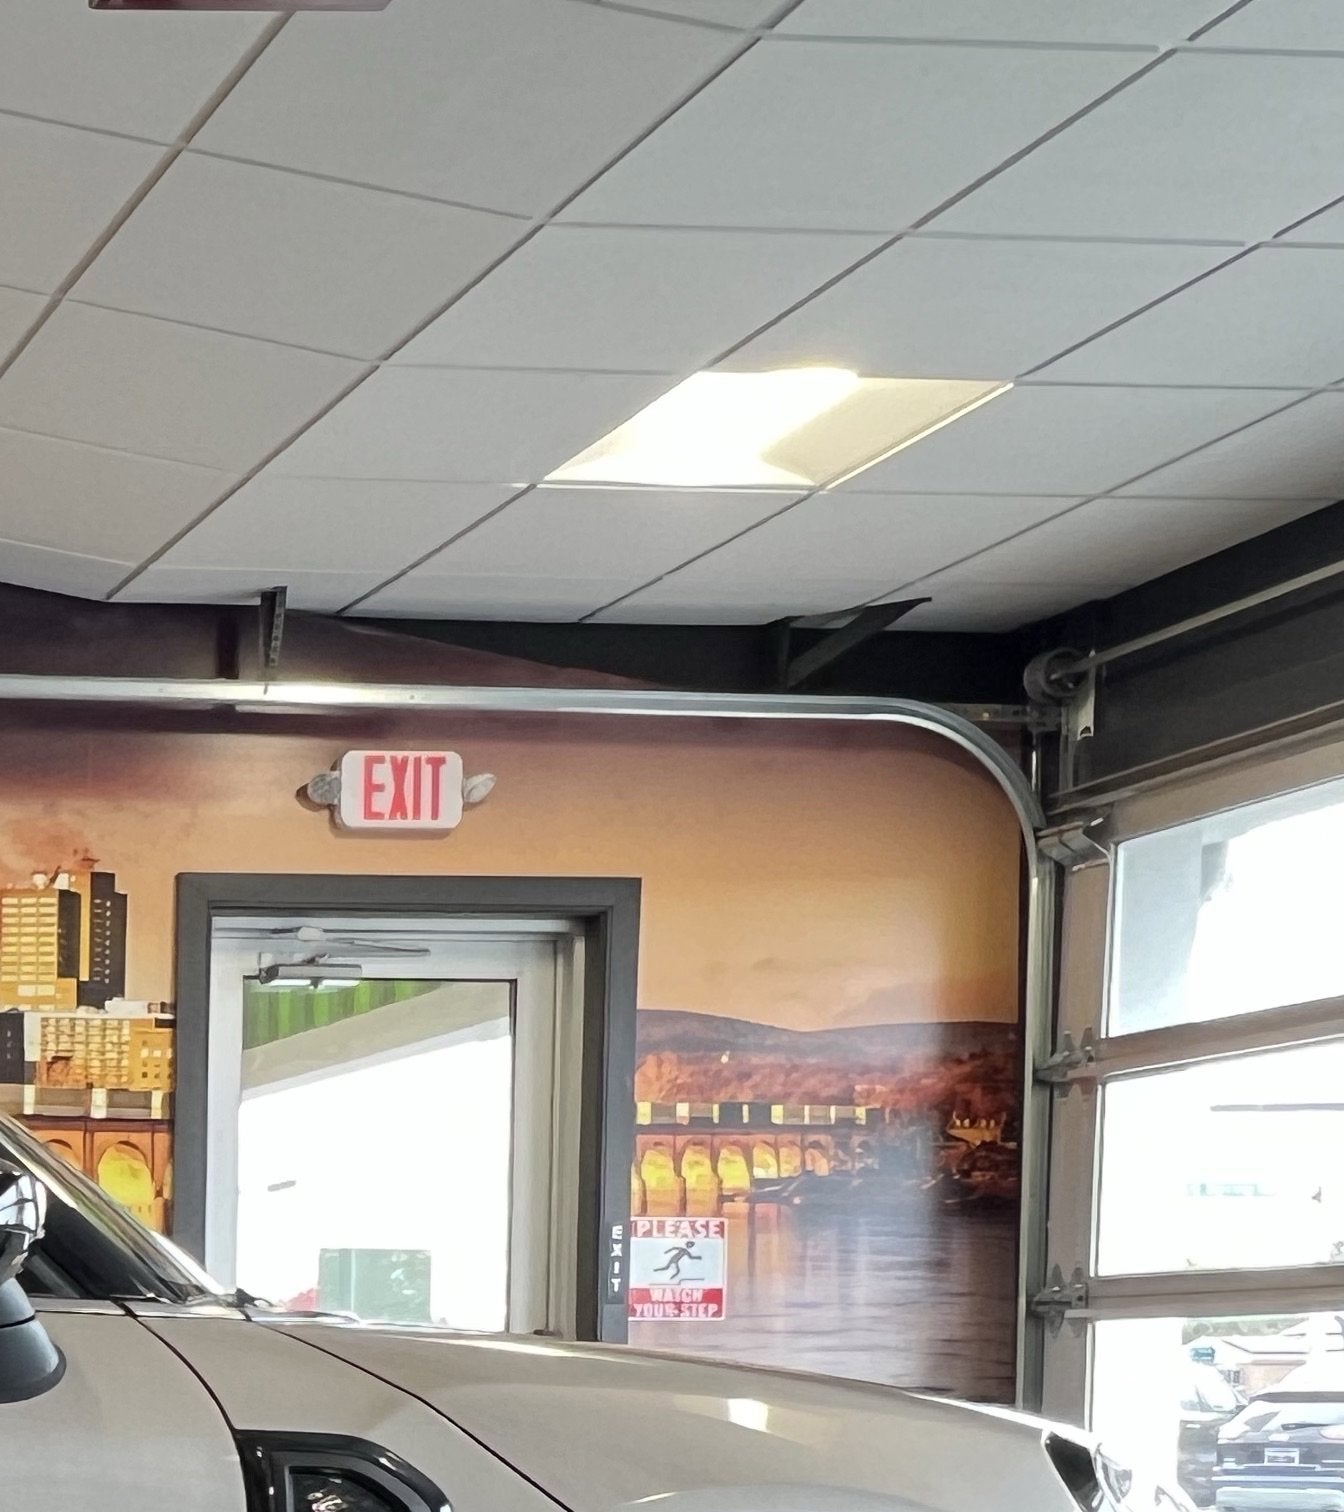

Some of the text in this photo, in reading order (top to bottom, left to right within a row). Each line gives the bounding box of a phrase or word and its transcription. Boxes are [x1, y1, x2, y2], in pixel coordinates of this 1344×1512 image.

[363, 755, 447, 821] EXIT
[636, 1219, 722, 1238] PLEASE
[610, 1225, 624, 1293] EXIT
[649, 1289, 704, 1303] WATCH
[633, 1303, 719, 1318] YOUR STEP
